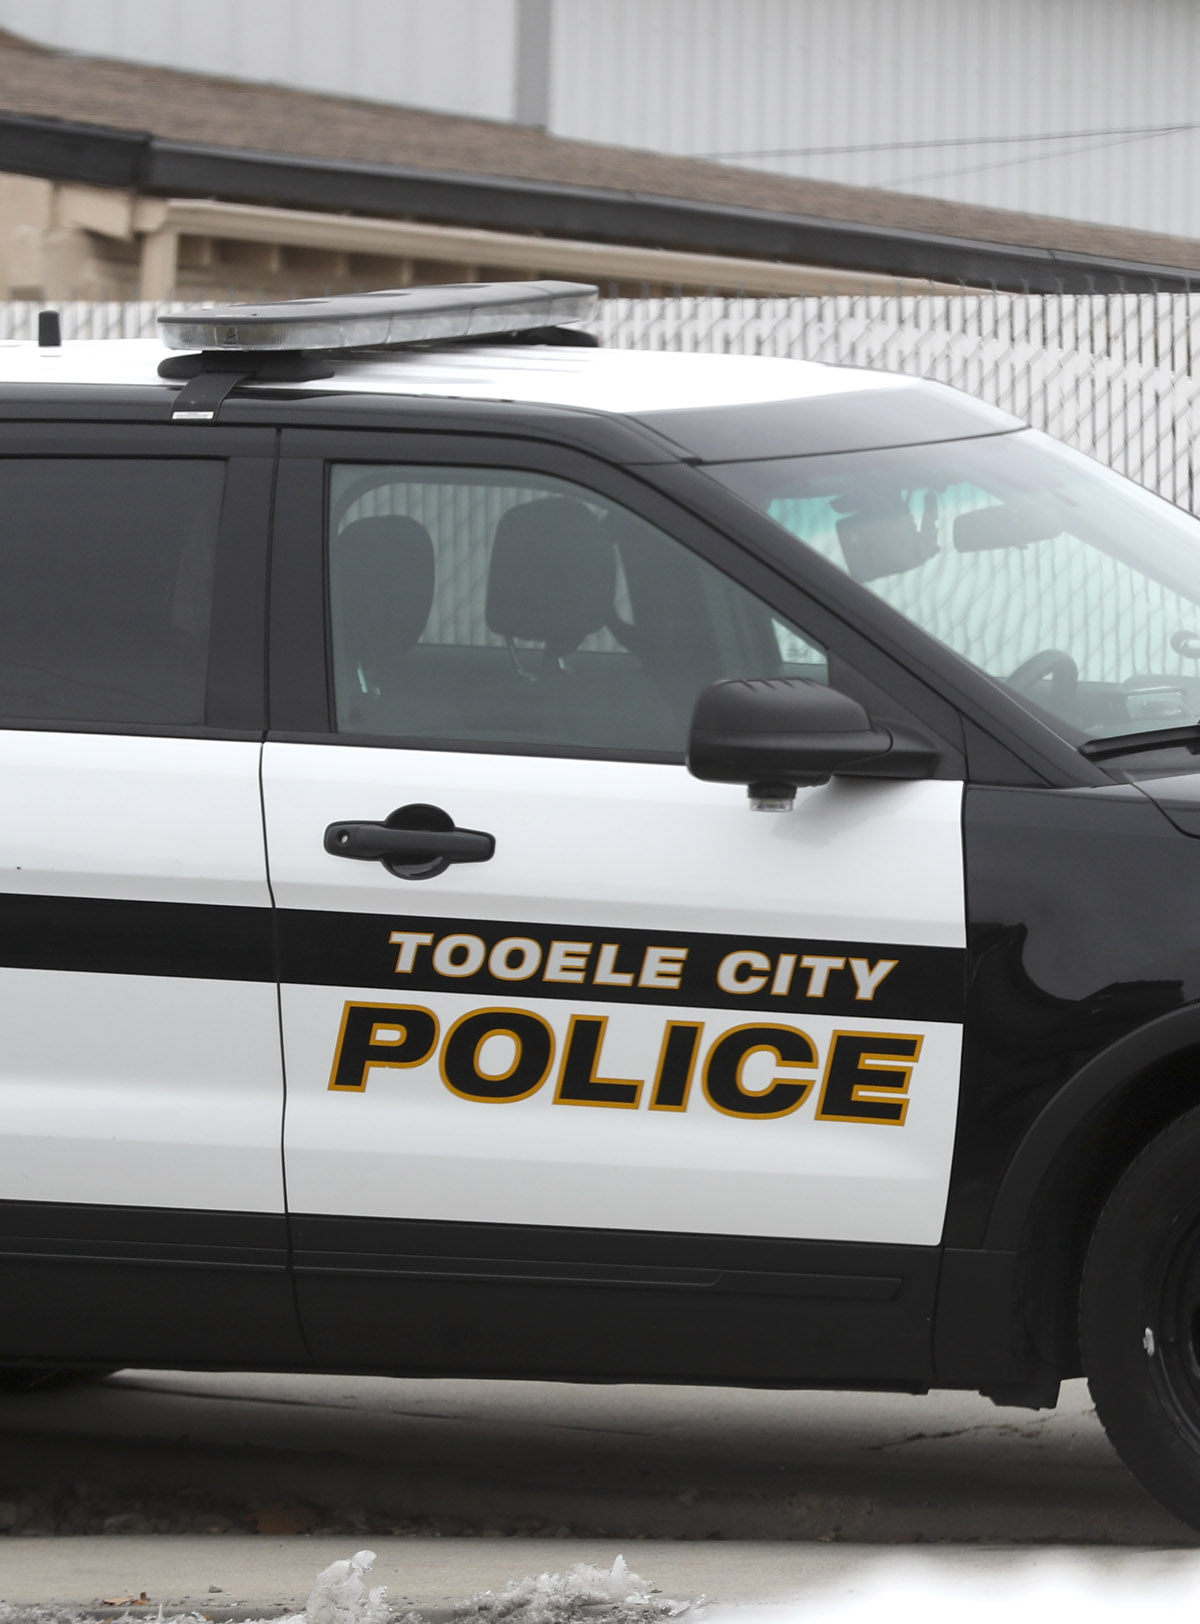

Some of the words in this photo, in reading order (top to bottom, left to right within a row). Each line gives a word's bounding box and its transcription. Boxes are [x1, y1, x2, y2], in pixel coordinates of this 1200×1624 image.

[387, 930, 690, 991] TOOELE
[715, 949, 899, 1001] CITY
[327, 1000, 926, 1127] POLICE
